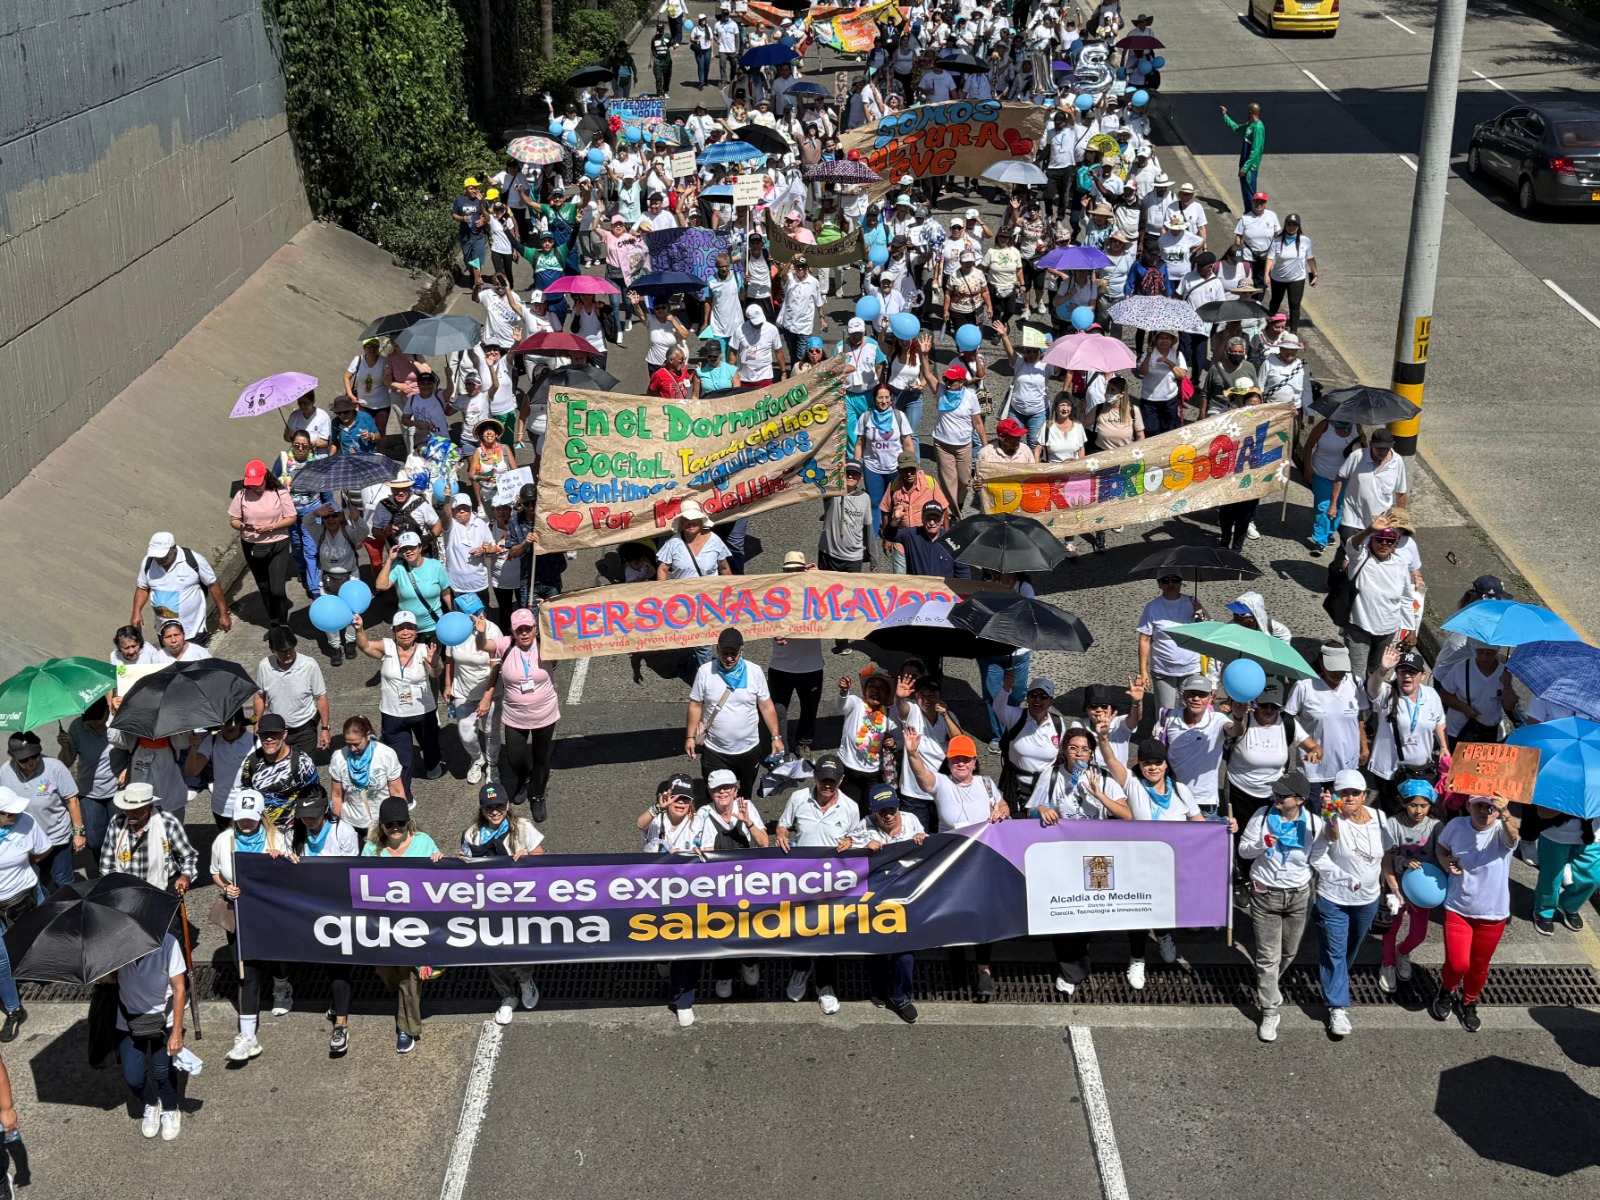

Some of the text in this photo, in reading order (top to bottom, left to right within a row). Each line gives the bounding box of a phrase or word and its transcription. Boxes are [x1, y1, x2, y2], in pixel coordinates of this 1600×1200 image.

[874, 99, 1003, 149] SOMOS
[889, 148, 957, 185] CVG
[662, 382, 809, 442] Dormitorio
[1163, 420, 1284, 491] SOCIAL
[589, 506, 634, 530] Por
[549, 586, 792, 641] PERSONAS
[609, 635, 631, 648] vida
[788, 620, 825, 633] castilla
[359, 861, 858, 910] La vejez es experiencia
[1049, 891, 1152, 904] Alcaldía de Medellín
[313, 892, 908, 955] que suma sabiduría
